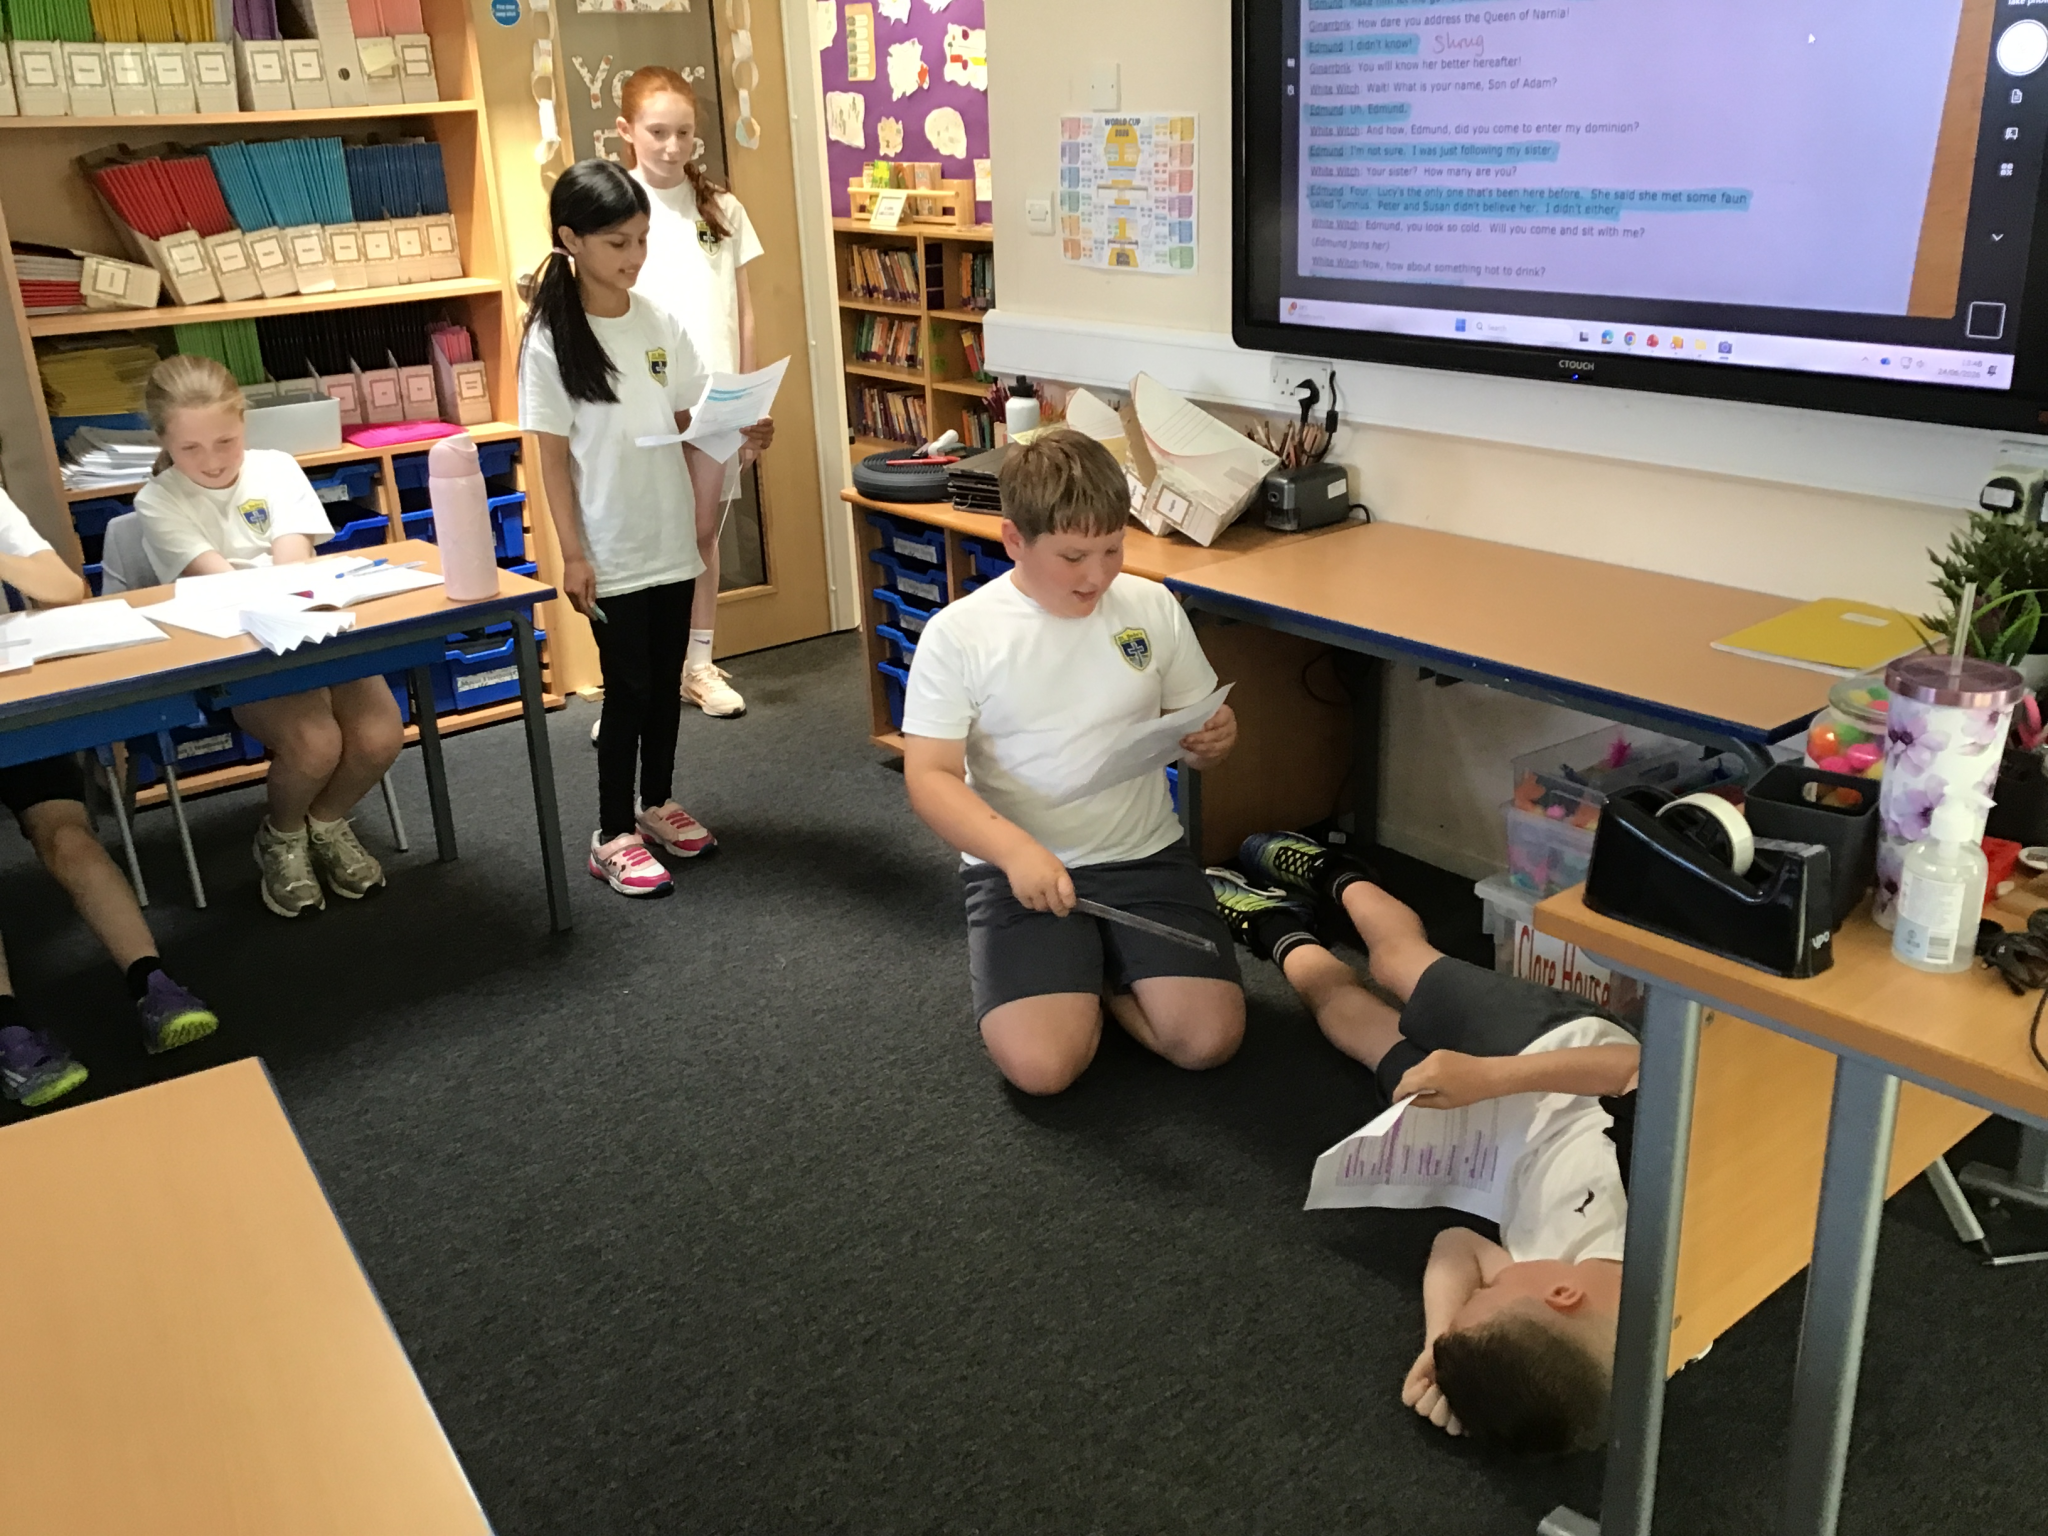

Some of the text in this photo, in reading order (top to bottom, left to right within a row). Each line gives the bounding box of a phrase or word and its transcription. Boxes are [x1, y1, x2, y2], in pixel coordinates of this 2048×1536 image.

[1358, 18, 1377, 28] How
[1381, 17, 1401, 27] dare
[1405, 16, 1421, 27] you
[1424, 14, 1461, 25] address
[1464, 13, 1480, 24] the
[1484, 11, 1516, 24] Queen
[1519, 8, 1530, 20] of
[1533, 7, 1570, 20] Narnia!
[1357, 39, 1381, 50] didn't
[1385, 38, 1412, 49] know!
[1433, 32, 1484, 57] Shrug
[1358, 61, 1375, 72] You
[1378, 60, 1392, 71] will
[1395, 60, 1419, 71] know
[1422, 59, 1438, 70] her
[1441, 58, 1470, 69] better
[1473, 56, 1521, 68] hereafter!
[1310, 84, 1333, 95] White
[1366, 82, 1390, 93] Wait!
[1393, 81, 1417, 92] What
[1420, 81, 1427, 92] is
[1430, 81, 1452, 93] your
[1454, 81, 1484, 92] name,
[1488, 79, 1507, 90] Son
[1510, 78, 1520, 89] of
[1523, 77, 1557, 88] Adam?
[1105, 117, 1141, 126] WORLD CUP
[1310, 125, 1333, 136] White
[1366, 125, 1384, 135] And
[1386, 124, 1408, 136] how,
[1410, 123, 1452, 136] Edmund,
[1455, 123, 1469, 134] did
[1472, 124, 1490, 135] you
[1493, 124, 1519, 134] come
[1522, 123, 1532, 133] to
[1535, 123, 1562, 133] enter
[1565, 123, 1581, 134] my
[1585, 121, 1640, 133] dominion?
[1350, 145, 1364, 155] I'm
[1367, 145, 1382, 156] not
[1420, 146, 1437, 156] was
[1439, 144, 1458, 157] just
[1461, 144, 1503, 157] following
[1506, 145, 1521, 157] my
[1524, 144, 1555, 156] sister.
[1311, 166, 1333, 176] White
[1366, 166, 1386, 177] Your
[1388, 166, 1417, 177] sister?
[1424, 166, 1443, 177] How
[1446, 167, 1472, 178] many
[1475, 167, 1491, 177] are
[1494, 166, 1517, 178] you?
[1378, 186, 1404, 198] Lucy's
[1407, 186, 1422, 197] the
[1425, 187, 1443, 199] only
[1446, 188, 1463, 198] one
[1466, 187, 1493, 198] that's
[1496, 187, 1519, 198] been
[1523, 187, 1545, 199] here
[1548, 187, 1583, 199] before.
[1591, 188, 1610, 200] She
[1614, 189, 1635, 201] said
[1638, 189, 1658, 201] she
[1661, 191, 1682, 202] met
[1686, 192, 1717, 203] some
[1721, 191, 1747, 204] faun
[1378, 200, 1401, 211] Peter
[1403, 201, 1420, 211] and
[1423, 201, 1450, 212] Susan
[1453, 202, 1480, 212] didn't
[1483, 202, 1516, 213] believe
[1553, 203, 1581, 215] didn't
[1365, 220, 1403, 232] Edmund,
[1406, 222, 1422, 233] you
[1425, 221, 1443, 232] look
[1447, 224, 1458, 233] so
[1461, 222, 1482, 233] cold.
[1489, 223, 1506, 234] Will
[1509, 224, 1526, 235] you
[1530, 225, 1556, 235] come
[1560, 224, 1578, 236] and
[1582, 225, 1594, 237] sit
[1598, 226, 1619, 237] with
[1622, 227, 1645, 239] me?
[1371, 240, 1390, 253] her)
[1386, 260, 1403, 270] how
[1407, 261, 1431, 272] about
[1434, 263, 1482, 276] something
[1485, 265, 1500, 275] hot
[1503, 265, 1512, 276] to
[1515, 266, 1545, 277] drink?
[1559, 360, 1595, 371] CTOUCH
